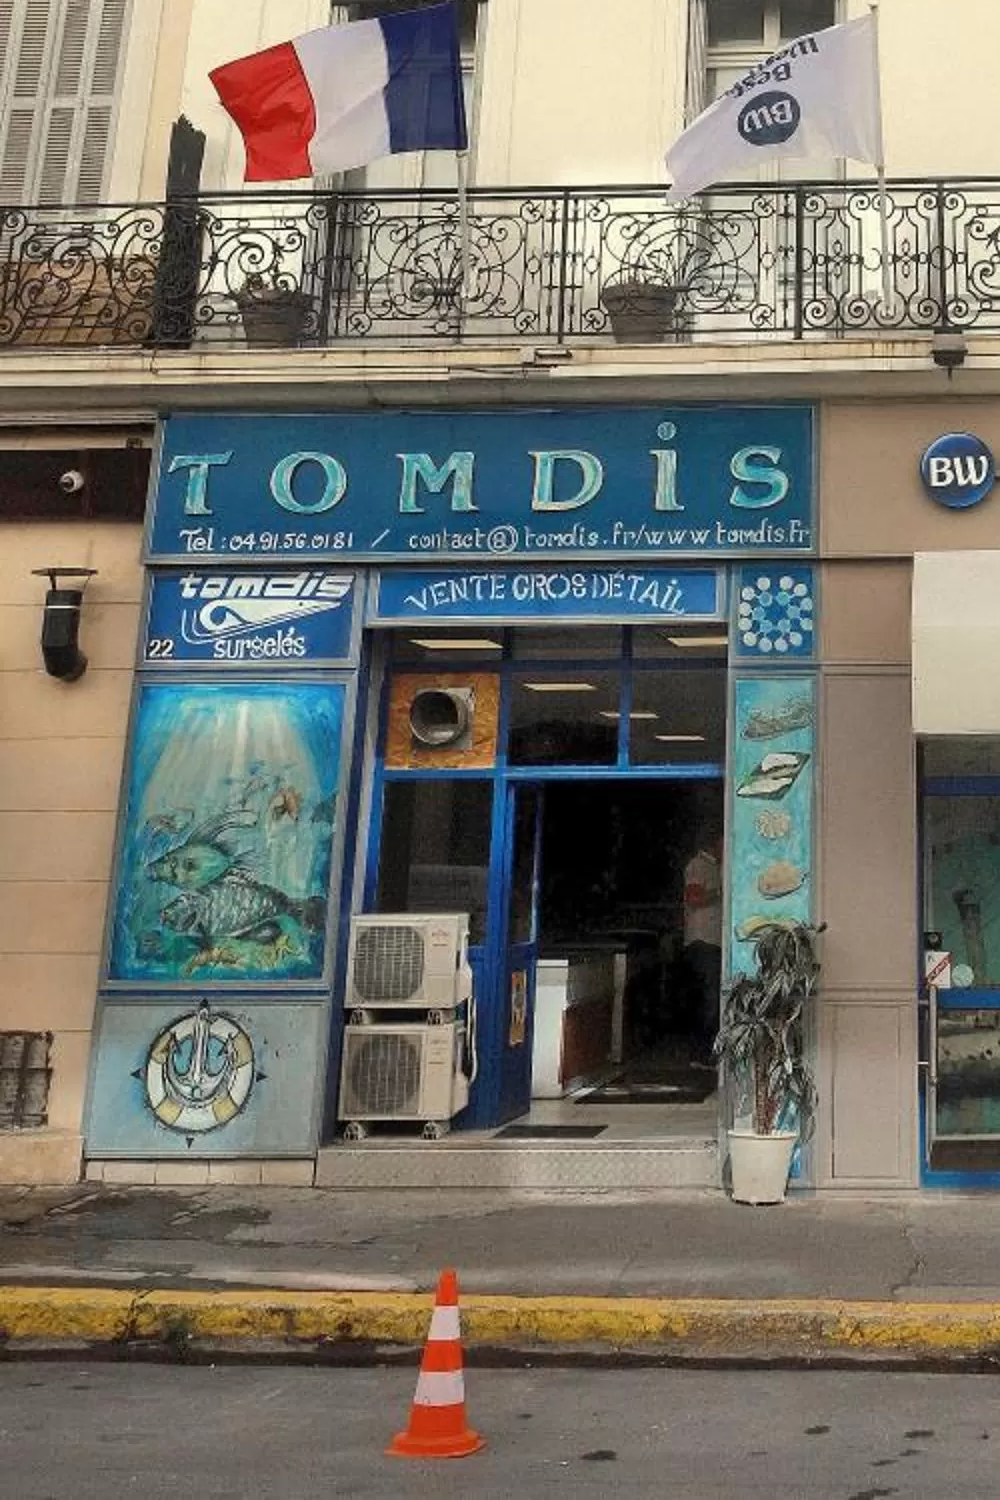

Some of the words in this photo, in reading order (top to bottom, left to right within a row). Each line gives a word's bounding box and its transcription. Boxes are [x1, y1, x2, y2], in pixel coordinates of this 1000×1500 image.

[743, 99, 793, 133] BW
[929, 455, 989, 487] BW
[180, 572, 354, 599] tomdis
[404, 574, 507, 612] VENTE
[149, 639, 174, 658] 22
[212, 627, 307, 659] surgelés
